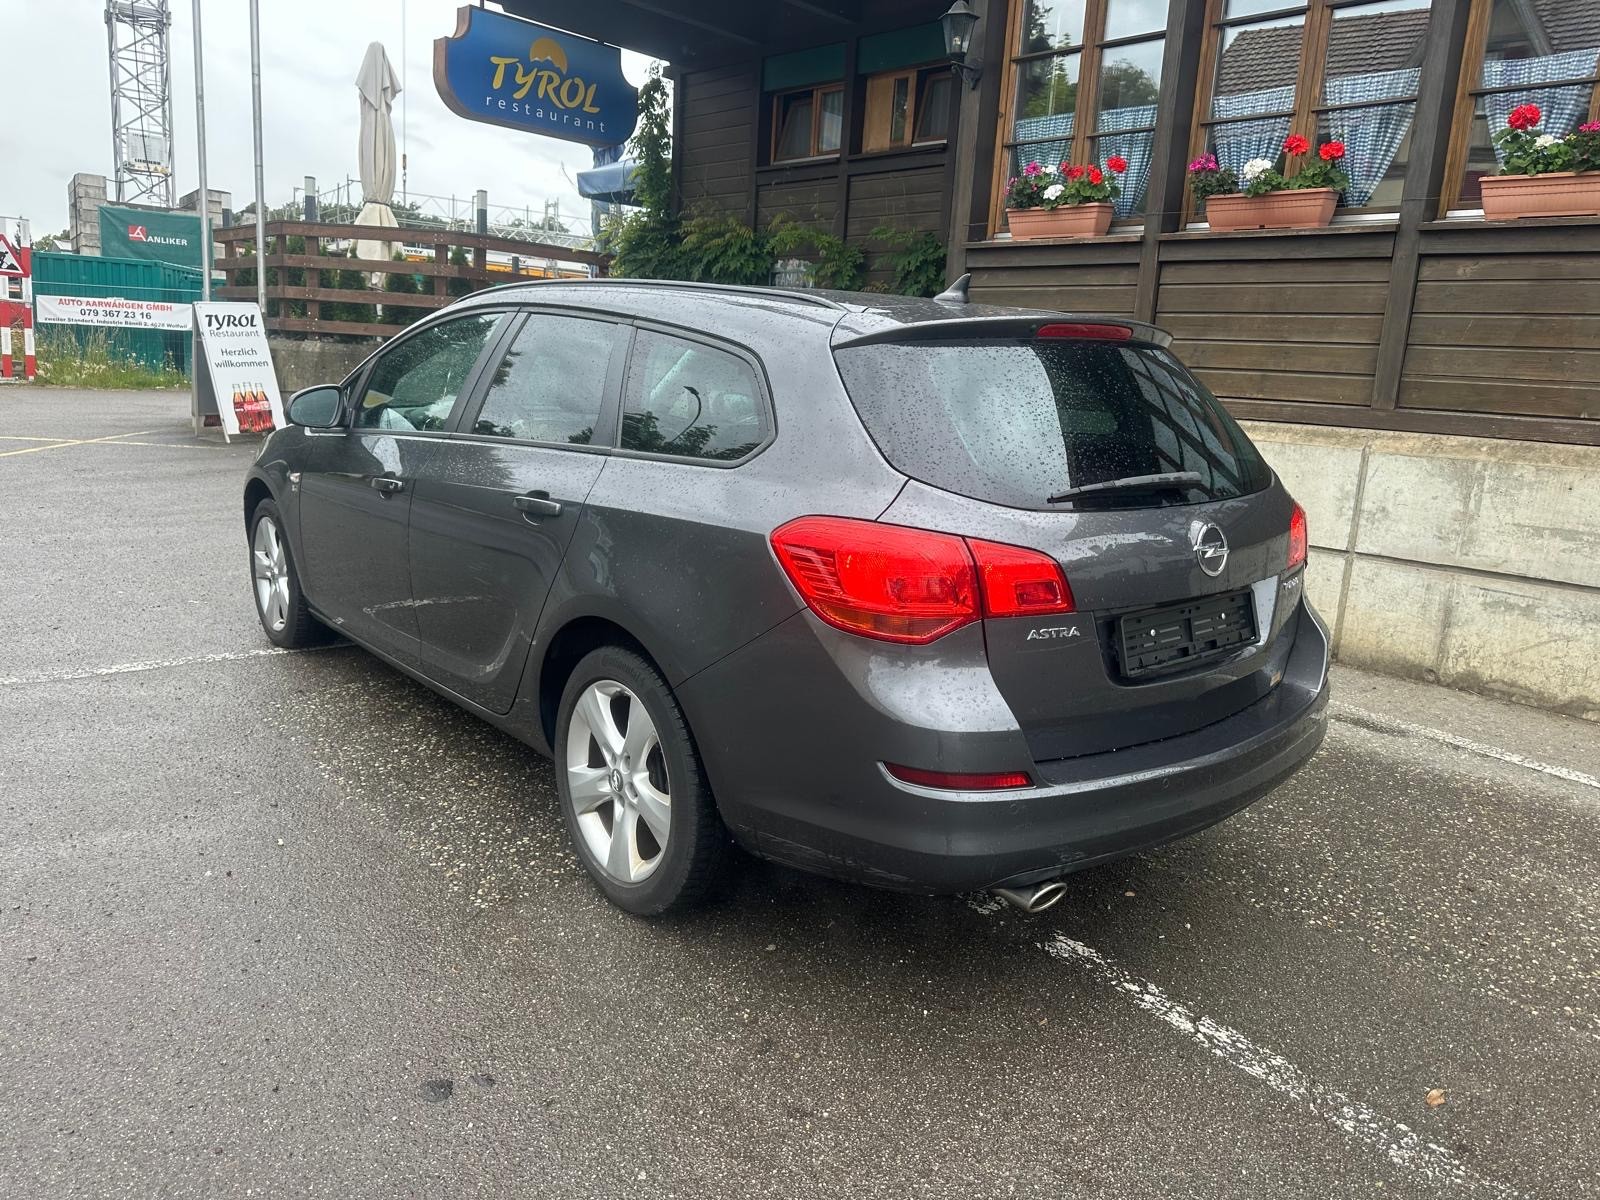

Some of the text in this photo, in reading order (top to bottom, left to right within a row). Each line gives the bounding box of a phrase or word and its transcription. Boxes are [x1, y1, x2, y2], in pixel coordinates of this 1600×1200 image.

[490, 56, 600, 113] TYROL
[486, 96, 605, 133] restaurant
[147, 235, 188, 246] ANLIKER
[58, 298, 173, 312] AUTO AARWANGEN GMBH
[80, 308, 152, 320] 079 367 23 16
[205, 314, 257, 330] TYROL
[209, 329, 260, 337] Restaurant
[221, 348, 257, 356] Herzlich
[214, 360, 269, 368] willkommen
[1027, 626, 1080, 640] ASTRA
